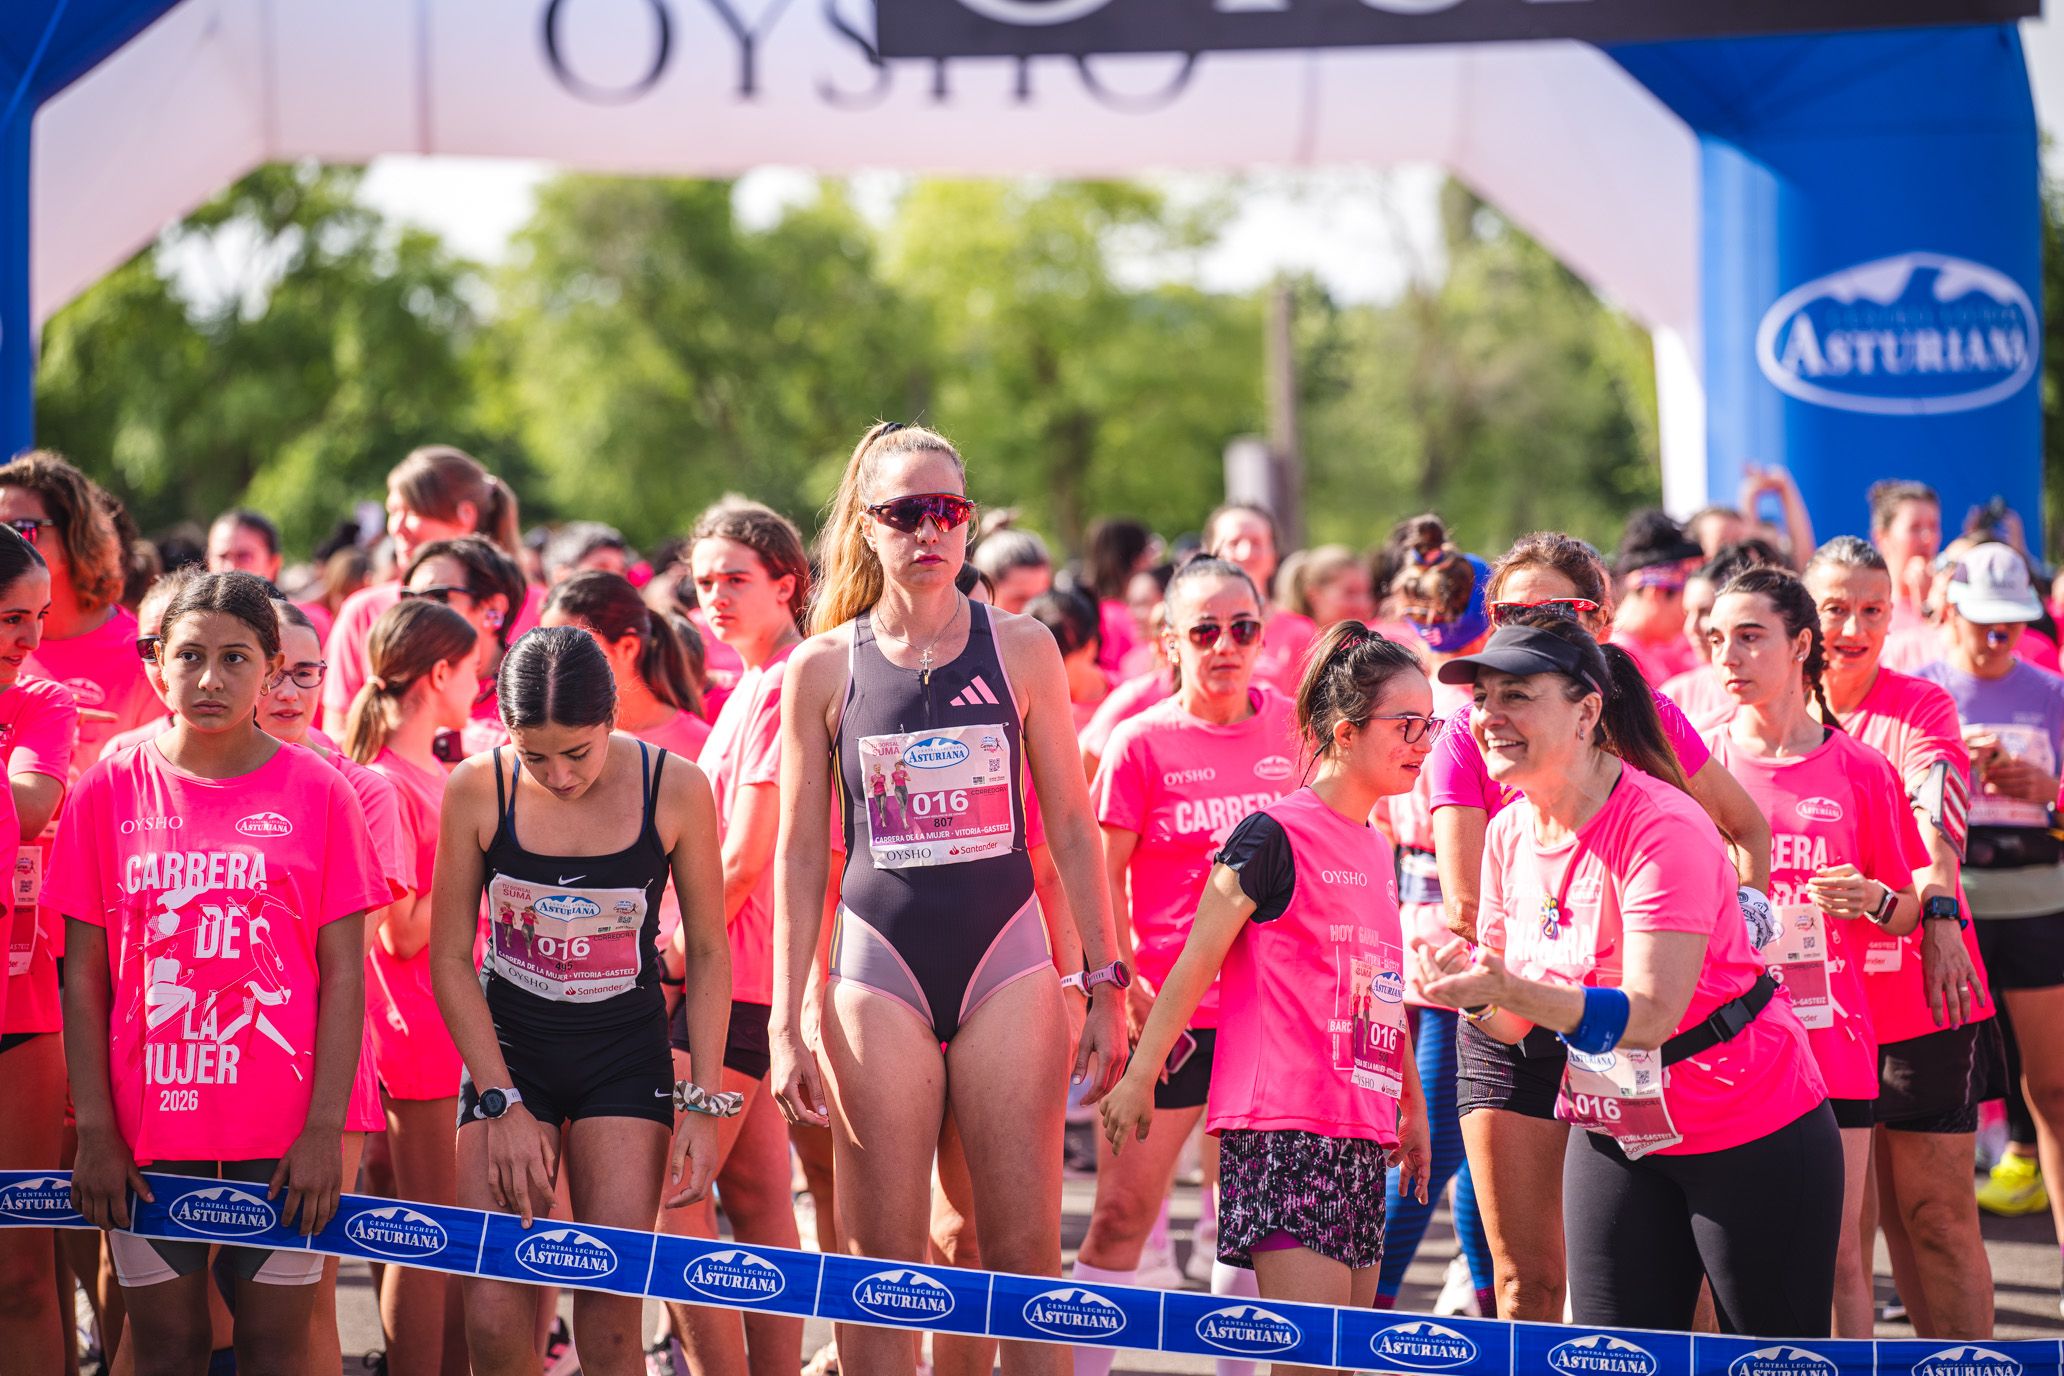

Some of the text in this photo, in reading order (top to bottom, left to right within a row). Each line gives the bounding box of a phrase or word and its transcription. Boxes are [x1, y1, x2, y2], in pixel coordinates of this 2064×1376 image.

[873, 747, 900, 756] SUMA
[909, 750, 965, 763] ASTURIANA
[1163, 767, 1216, 786] OYSHO
[912, 789, 969, 816] 016
[121, 815, 184, 834] OYSHO
[240, 821, 288, 832] ASTURIANA
[934, 817, 953, 828] 807
[875, 835, 905, 844] CARRERA
[915, 832, 925, 840] LA
[926, 830, 950, 839] MUJER
[954, 823, 1009, 837] VITORIA-GASTEIZ
[886, 842, 998, 861] OYSHO Santander
[126, 851, 268, 895] CARRERA
[1322, 870, 1368, 887] OYSHO
[503, 889, 532, 901] SUMA
[540, 901, 595, 916] ASTURIANA
[193, 903, 249, 959] DE
[1329, 924, 1354, 943] HOY
[537, 936, 591, 960] 016
[498, 950, 526, 968] CARRERA
[536, 965, 545, 975] LA
[545, 970, 568, 980] MUJER
[573, 968, 635, 979] VITORIA-GASTEIZ
[508, 967, 623, 996] OYSHO Santander
[182, 990, 219, 1041] LA
[1371, 1023, 1398, 1051] 016
[159, 1090, 199, 1111] 2026
[1575, 1094, 1622, 1120] 016
[0, 1193, 73, 1210] ASTURIA
[194, 1201, 266, 1213] CENTRAL LECHERA
[177, 1201, 269, 1228] ASTURIANA
[352, 1219, 439, 1249] ASTURIANA
[369, 1220, 438, 1234] CENTRAL LECHERA
[521, 1243, 610, 1272] ASTURIANA
[540, 1243, 608, 1257] CENTRAL LECHERA
[690, 1264, 777, 1293] ASTURIANA
[708, 1264, 776, 1278] CENTRAL LECHERA
[859, 1284, 947, 1312] ASTURIANA
[876, 1284, 945, 1297] CENTRAL LECHERA
[1030, 1303, 1118, 1330] ASTURIANA
[1047, 1303, 1116, 1316] CENTRAL LECHERA
[1203, 1320, 1292, 1344] ASTURIANA
[1377, 1335, 1468, 1359] ASTURIANA
[1555, 1349, 1648, 1374] ASTURIANA
